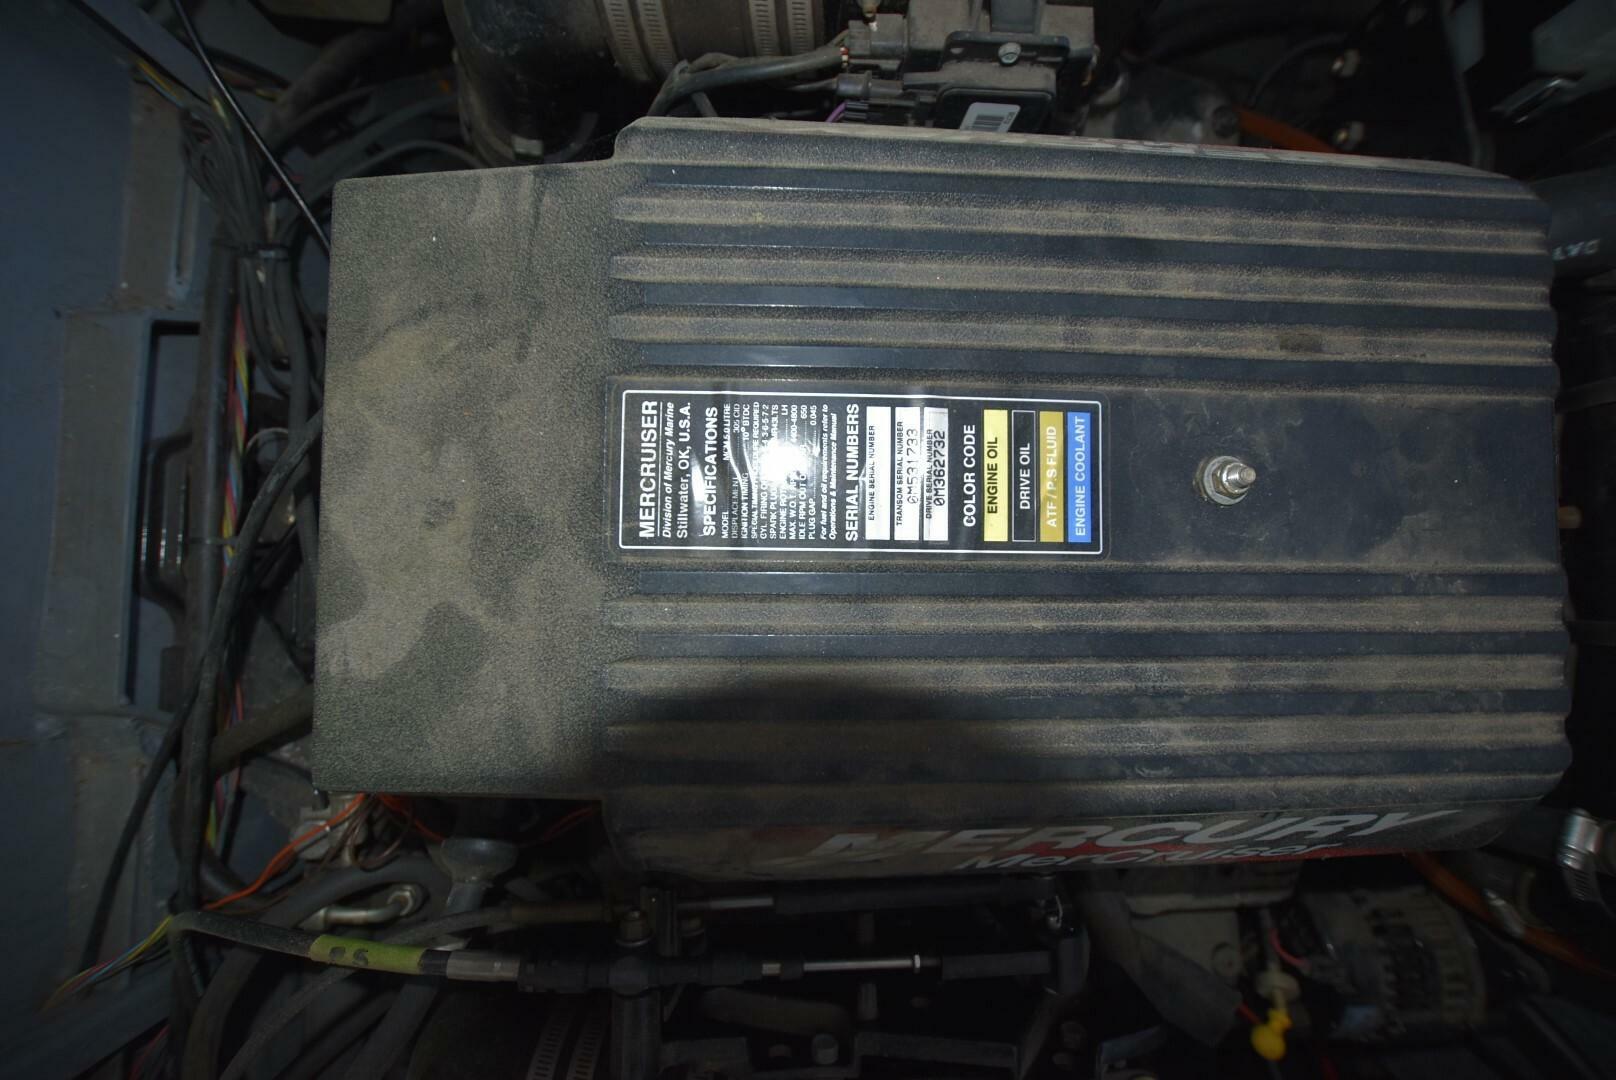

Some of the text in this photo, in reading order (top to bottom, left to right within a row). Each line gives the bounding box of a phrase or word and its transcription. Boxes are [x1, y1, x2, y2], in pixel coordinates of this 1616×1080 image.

[723, 403, 731, 427] LITRE
[781, 405, 788, 416] LH
[822, 404, 828, 413] to
[639, 401, 657, 538] MERCRUISER
[663, 402, 675, 538] Division of Mercury Marine
[677, 402, 691, 538] Stillwater, OK, U.S.A.
[703, 407, 718, 536] SPECIFICATIONS
[821, 433, 829, 482] requirements
[846, 404, 859, 541] SERIAL NUMBERS
[933, 430, 946, 506] 0M362732
[1047, 426, 1057, 465] FLUID
[799, 483, 807, 500] OUT
[963, 425, 976, 527] COLOR CODE
[987, 437, 998, 514] ENGINE OIL
[1020, 443, 1030, 510] DRIVE OIL
[1075, 416, 1086, 536] ENGINE COOLANT
[779, 508, 787, 539] ENGINE
[829, 499, 838, 540] Operations
[1048, 502, 1057, 527] ATF
[810, 808, 1462, 857] MERCURY
